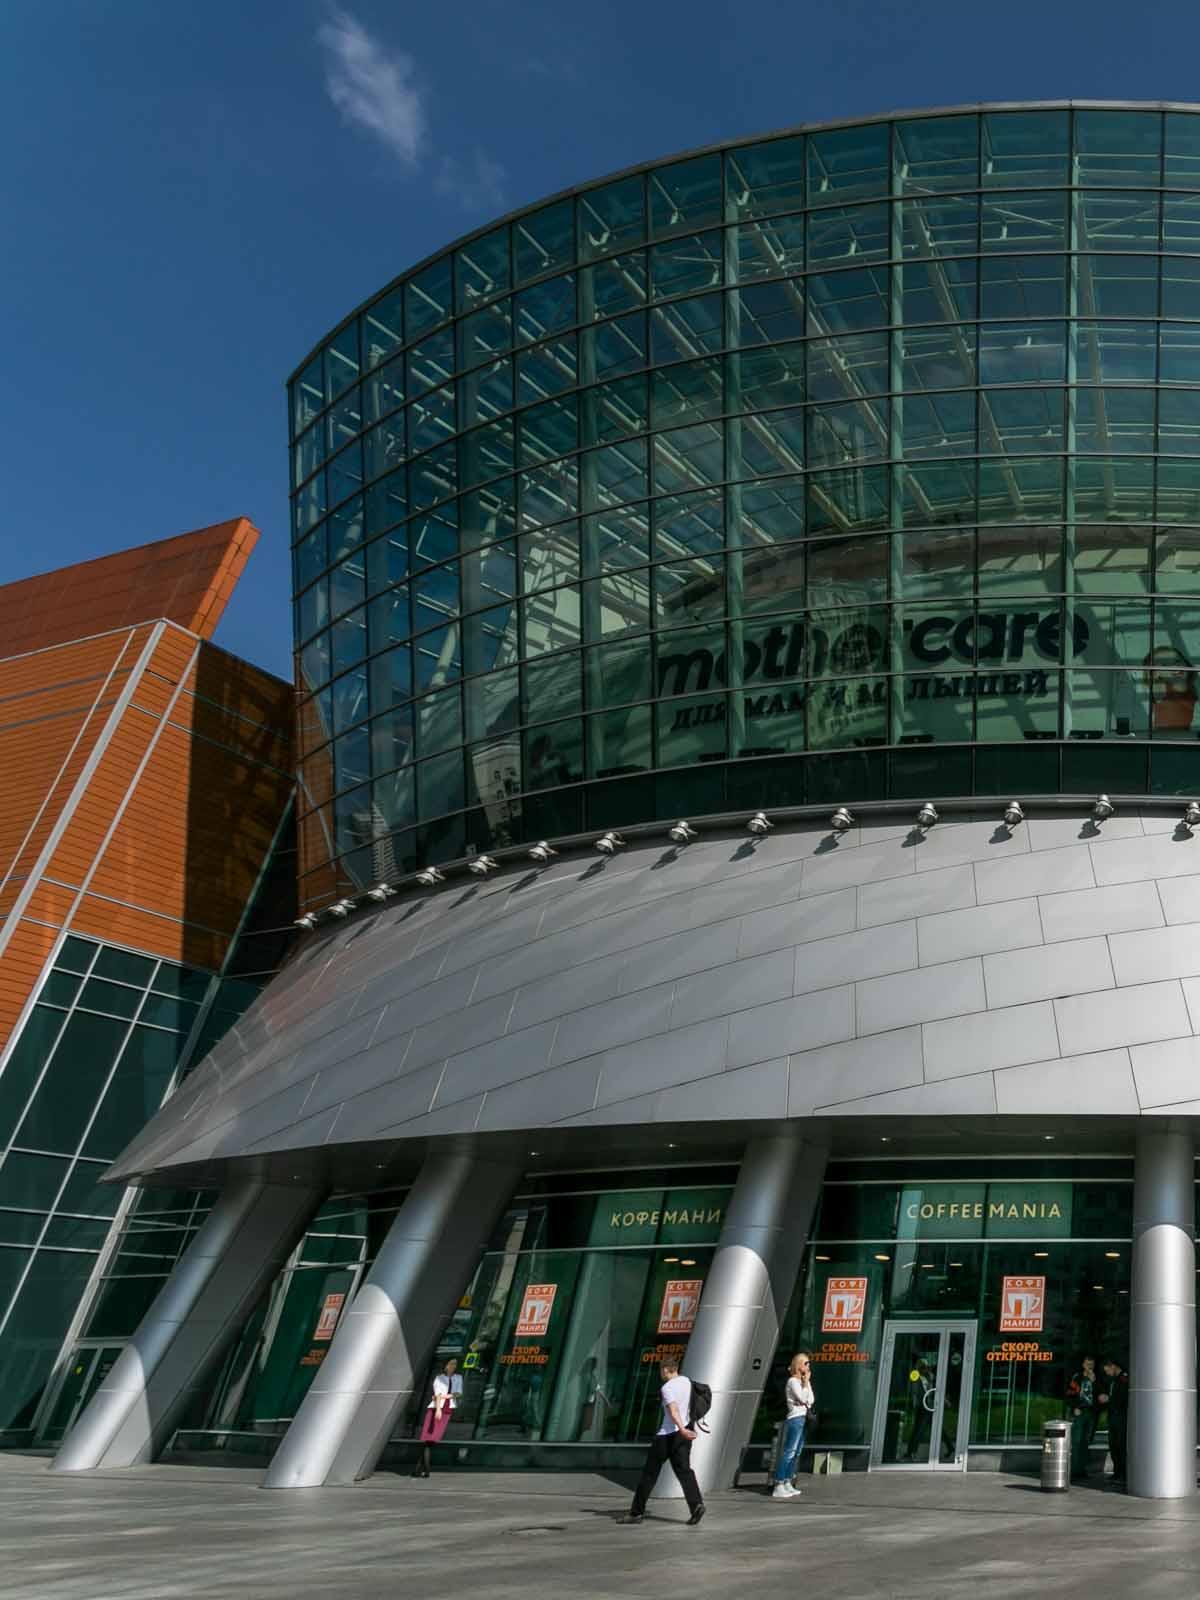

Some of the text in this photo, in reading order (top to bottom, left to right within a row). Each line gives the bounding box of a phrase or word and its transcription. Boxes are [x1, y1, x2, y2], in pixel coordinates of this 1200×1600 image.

[856, 669, 1048, 705] МЛЫШЕЙ
[610, 1209, 721, 1227] КОФЕМАНИ
[825, 1320, 860, 1329] МАНИЯ
[1003, 1320, 1040, 1328] МАНИЯ
[822, 1343, 857, 1352] СКОРО
[1001, 1342, 1039, 1352] СКОРО
[986, 1351, 1053, 1361] ОТКРЫТИЕ!
